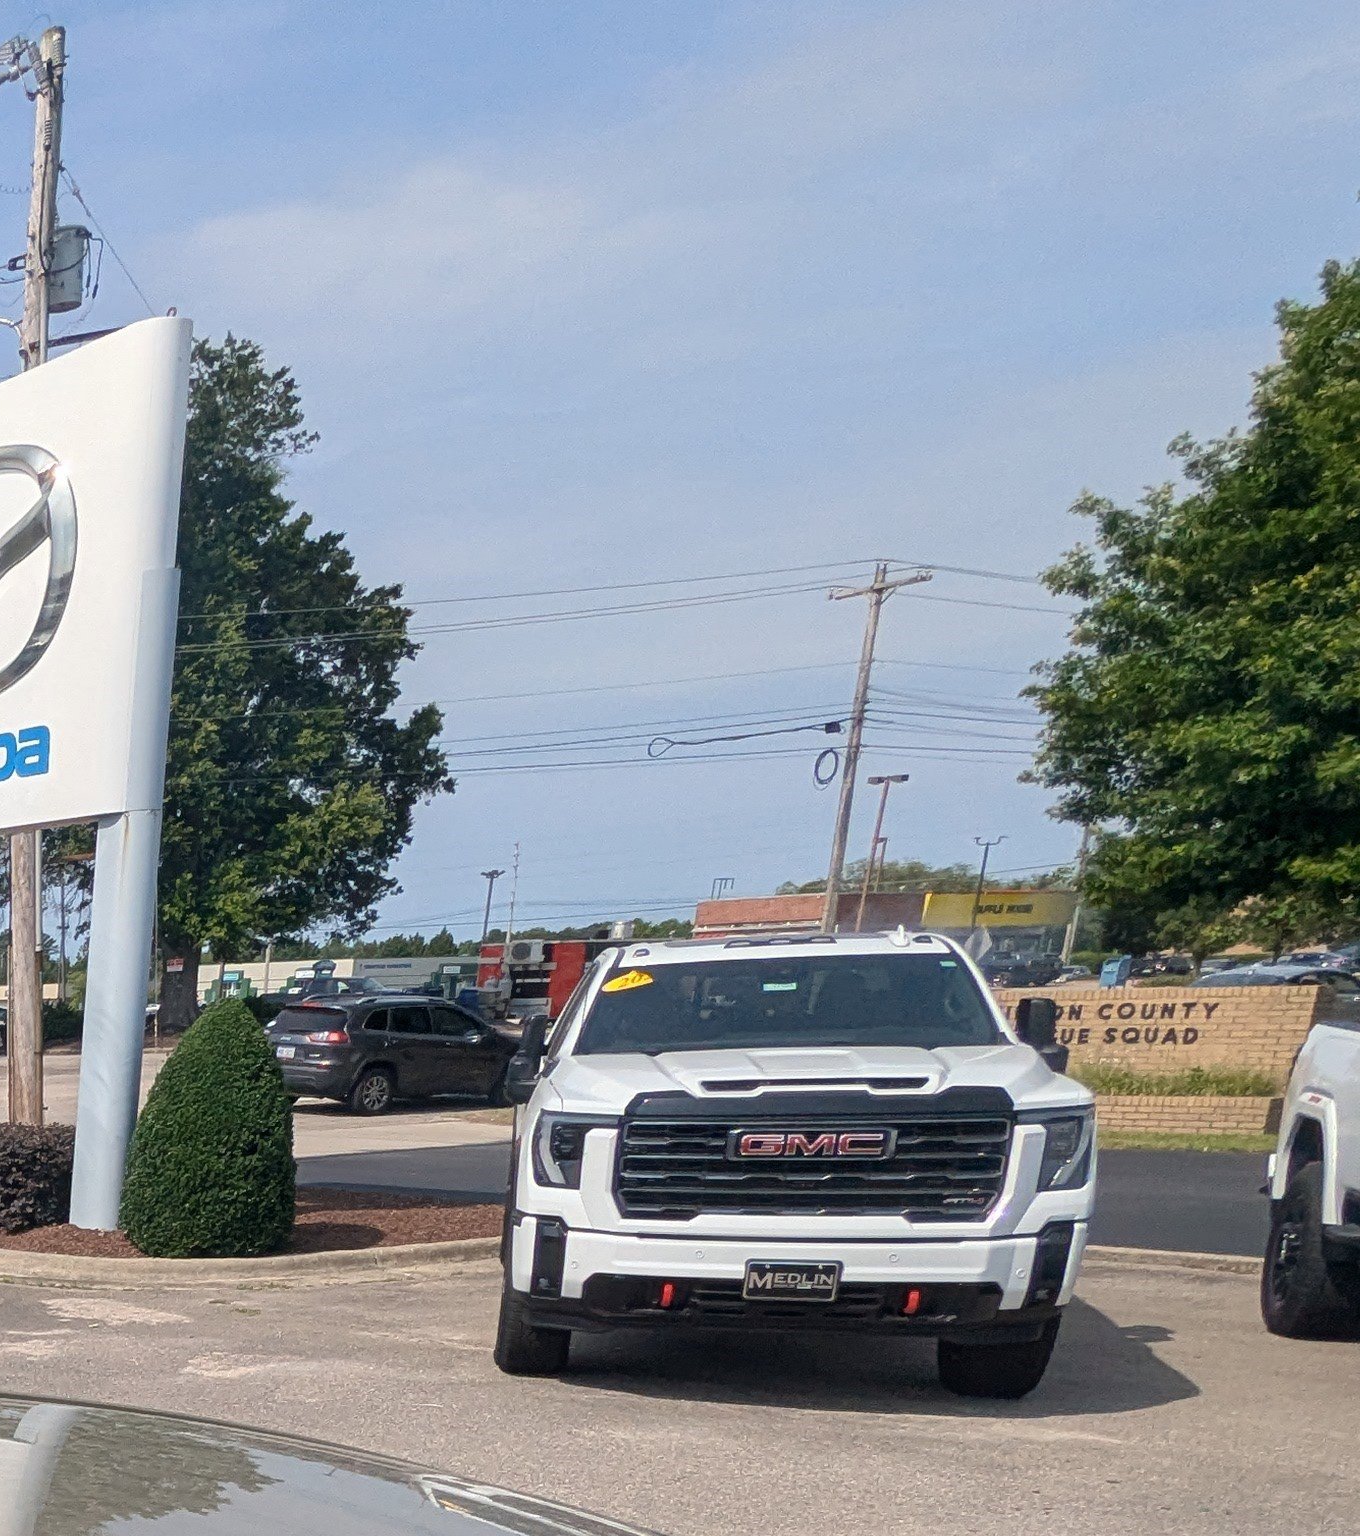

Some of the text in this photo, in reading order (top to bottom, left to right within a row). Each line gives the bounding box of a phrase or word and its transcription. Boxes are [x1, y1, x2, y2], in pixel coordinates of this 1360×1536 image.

[1098, 1002, 1220, 1020] COUNTY
[1102, 1027, 1200, 1045] SQUAD
[740, 1133, 884, 1156] GMC
[748, 1271, 835, 1289] MEDLIN
